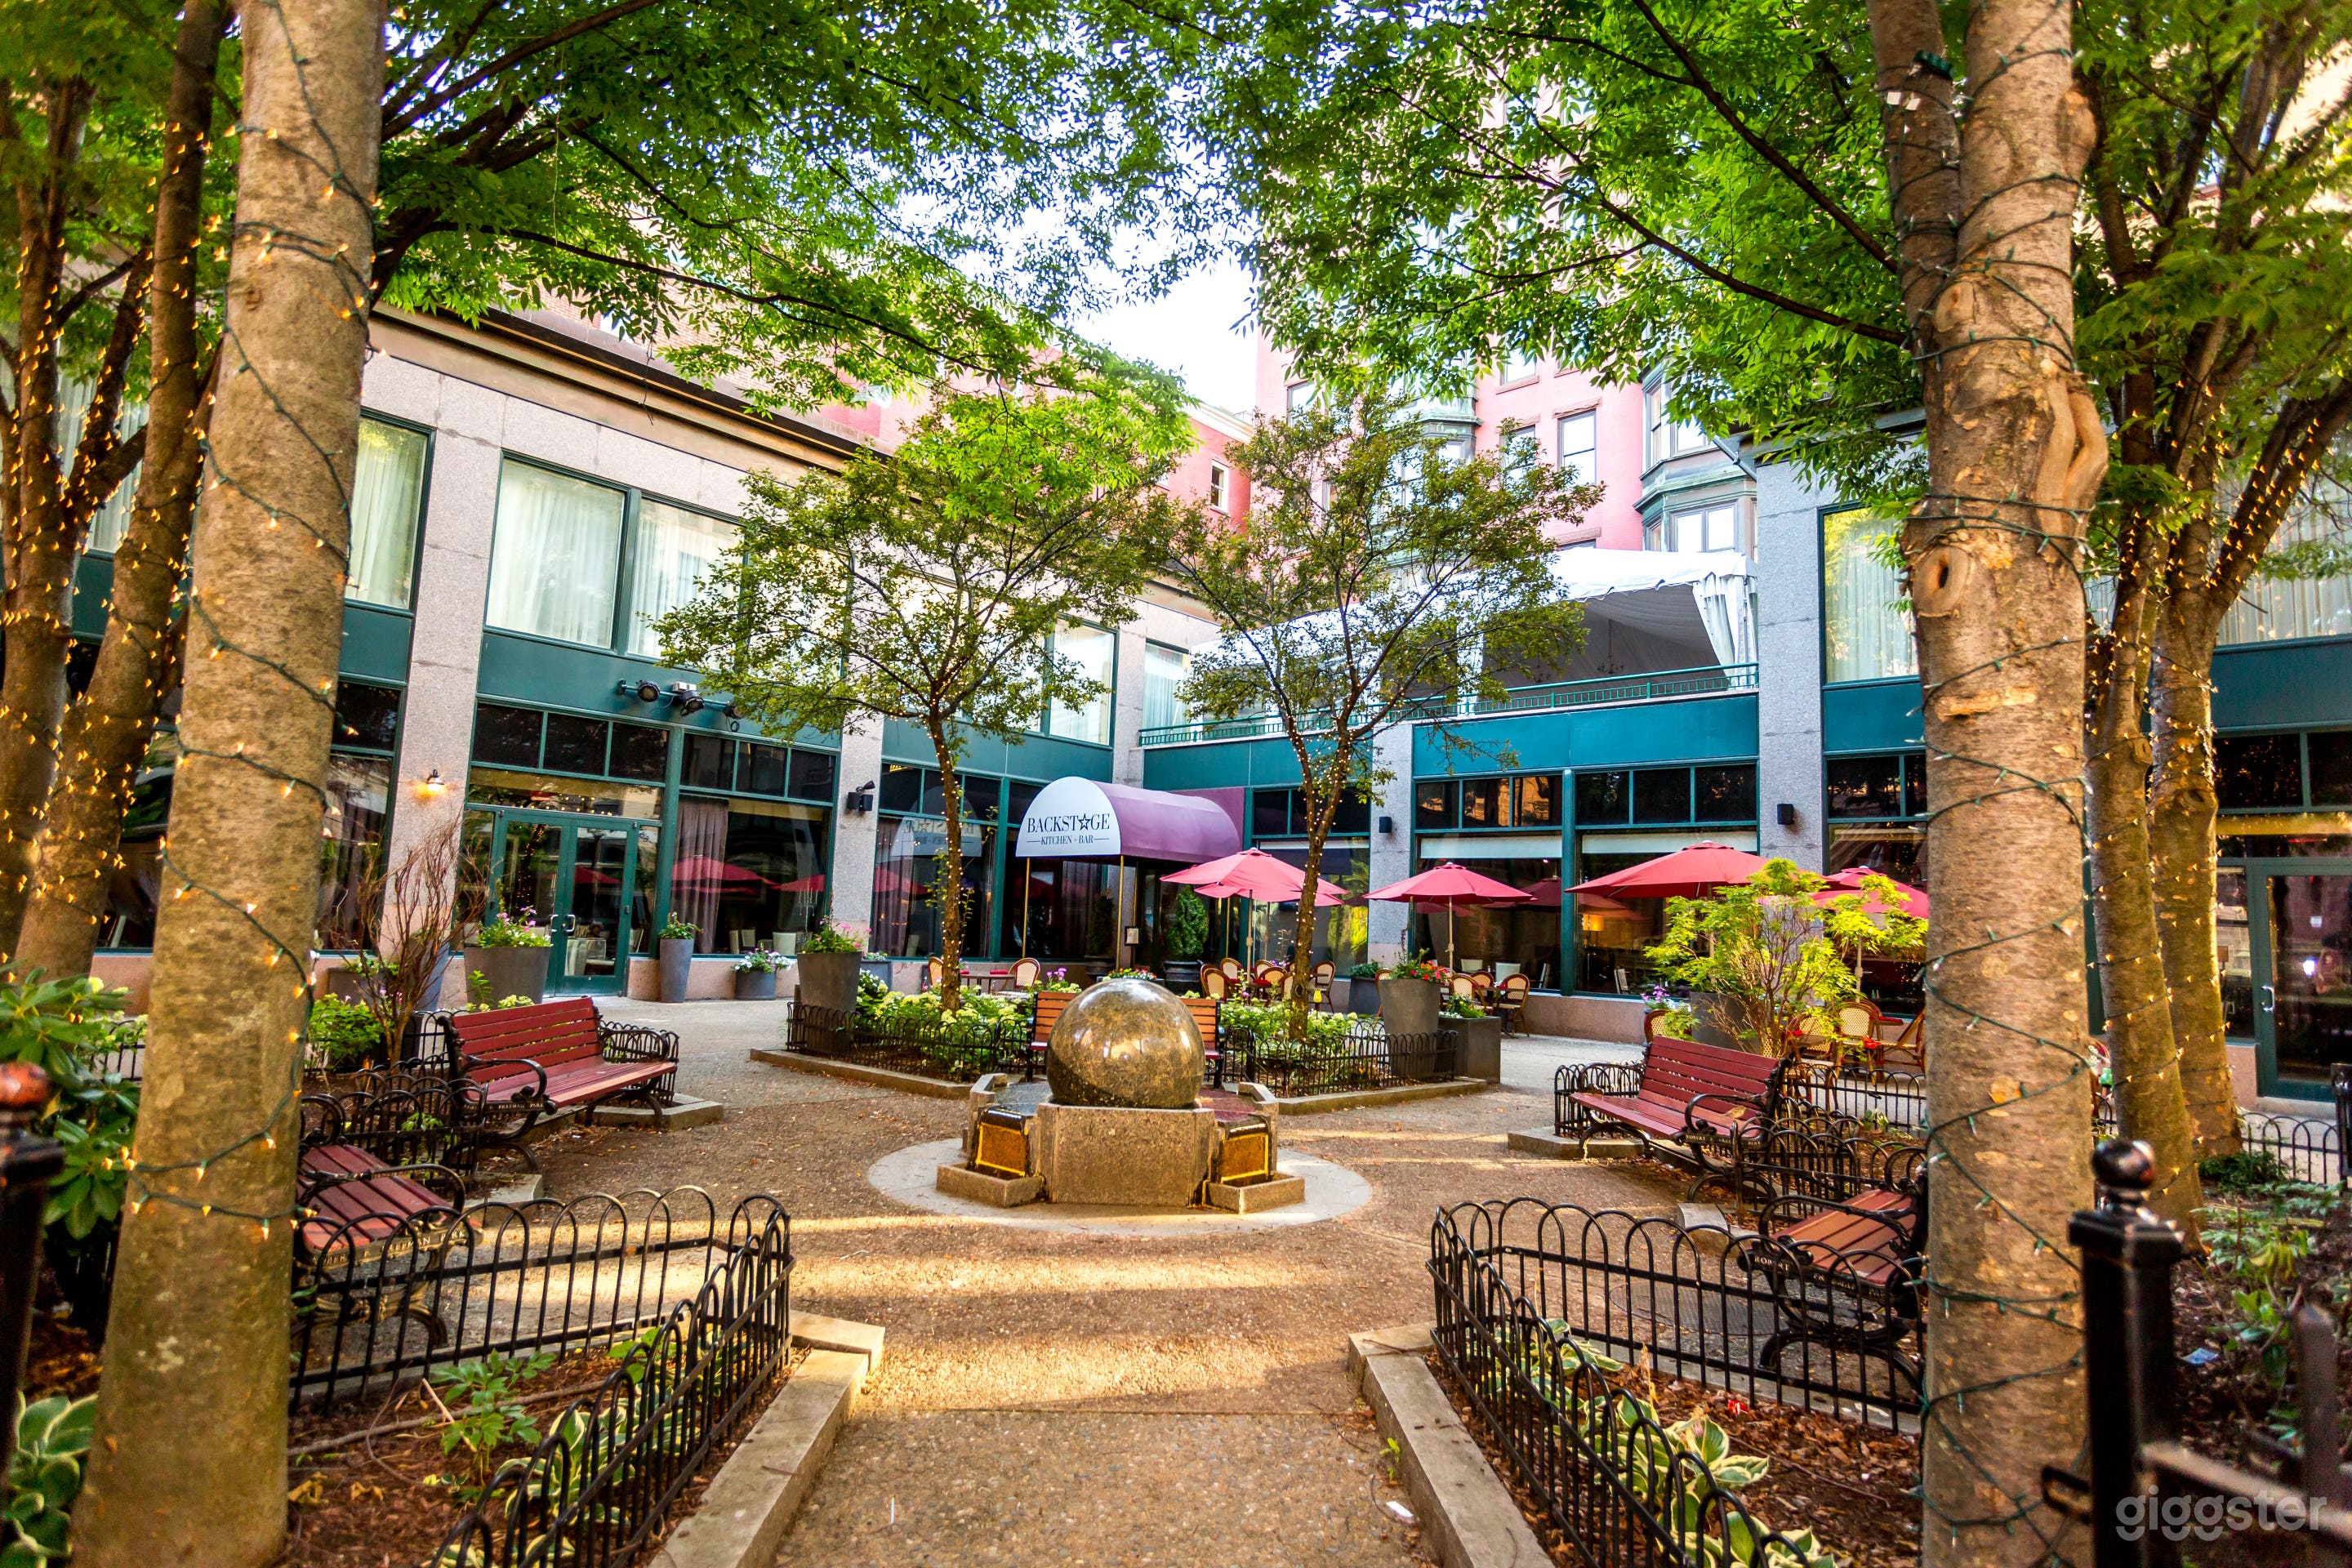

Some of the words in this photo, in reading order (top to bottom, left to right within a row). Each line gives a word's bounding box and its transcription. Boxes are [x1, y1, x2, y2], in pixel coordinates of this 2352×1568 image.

[1040, 835, 1072, 845] KITCHEN
[1079, 835, 1094, 844] BAR
[440, 1231, 465, 1241] PRK
[1754, 1254, 1788, 1271] ROBRT
